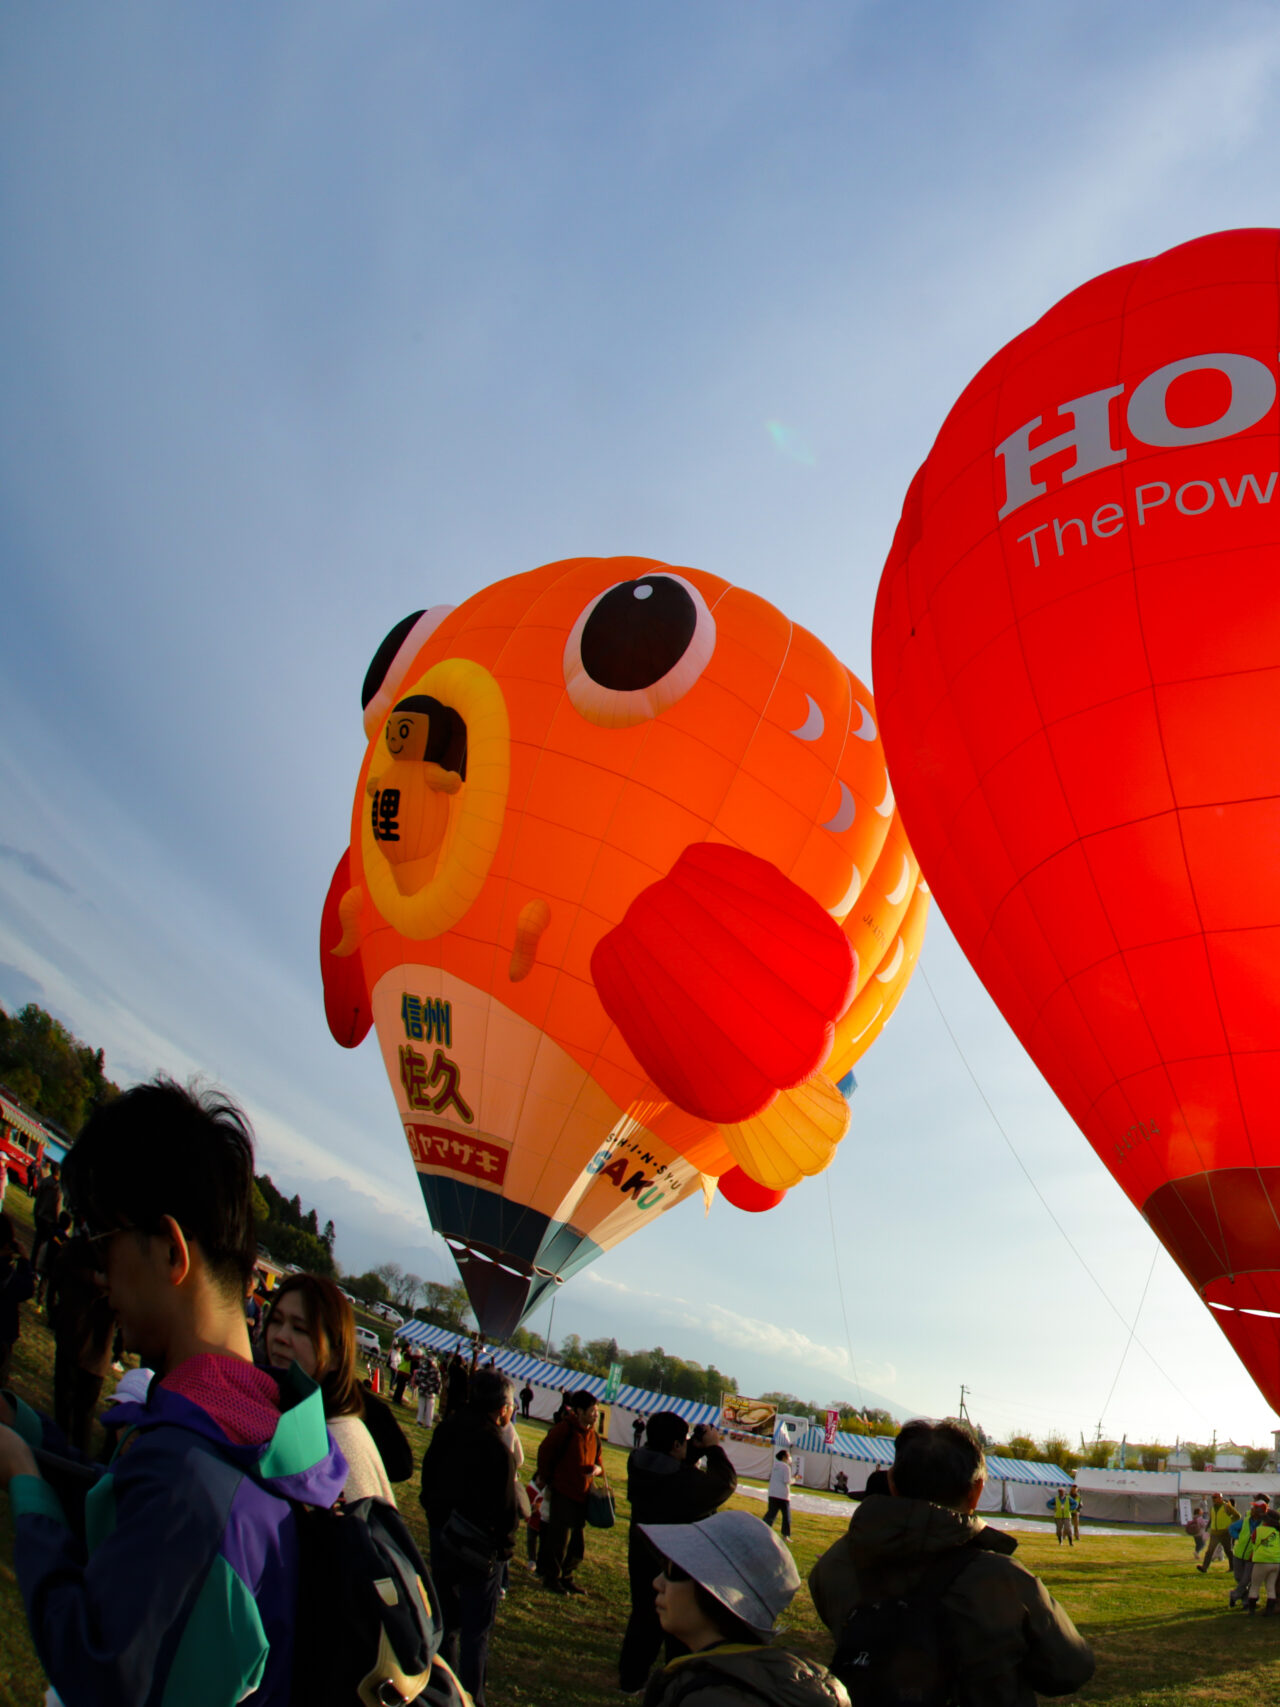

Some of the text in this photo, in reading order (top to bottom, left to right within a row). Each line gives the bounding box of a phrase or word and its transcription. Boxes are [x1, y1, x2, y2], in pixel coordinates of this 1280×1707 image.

[1017, 503, 1124, 568] The
[402, 992, 452, 1049] 信州
[398, 1045, 474, 1124] 佐久
[418, 1132, 499, 1173] ヤマザキ
[586, 1150, 665, 1210] SAKU
